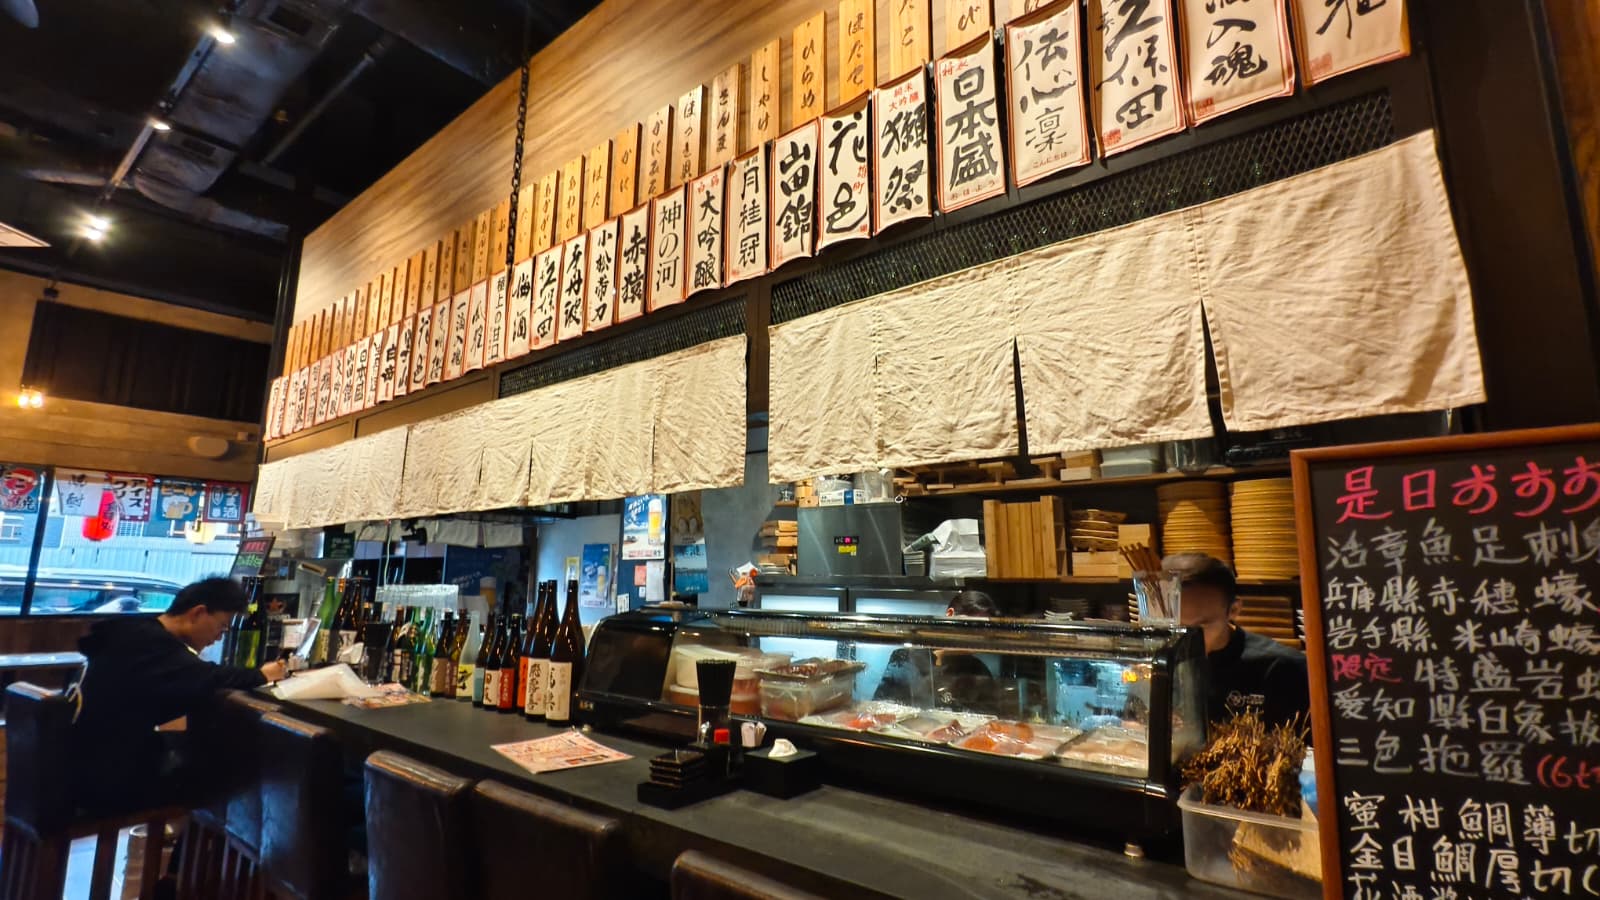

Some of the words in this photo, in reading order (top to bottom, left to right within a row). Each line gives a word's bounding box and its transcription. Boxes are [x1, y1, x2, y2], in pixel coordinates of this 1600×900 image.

[800, 37, 817, 110] ひらめ
[1205, 0, 1269, 86] 入魂
[715, 88, 731, 154] さんま
[945, 65, 1001, 192] 日本盛
[738, 165, 763, 268] 月桂冠
[776, 140, 813, 253] 山田錦
[621, 224, 647, 305] 赤猿
[656, 200, 682, 293] 神の河
